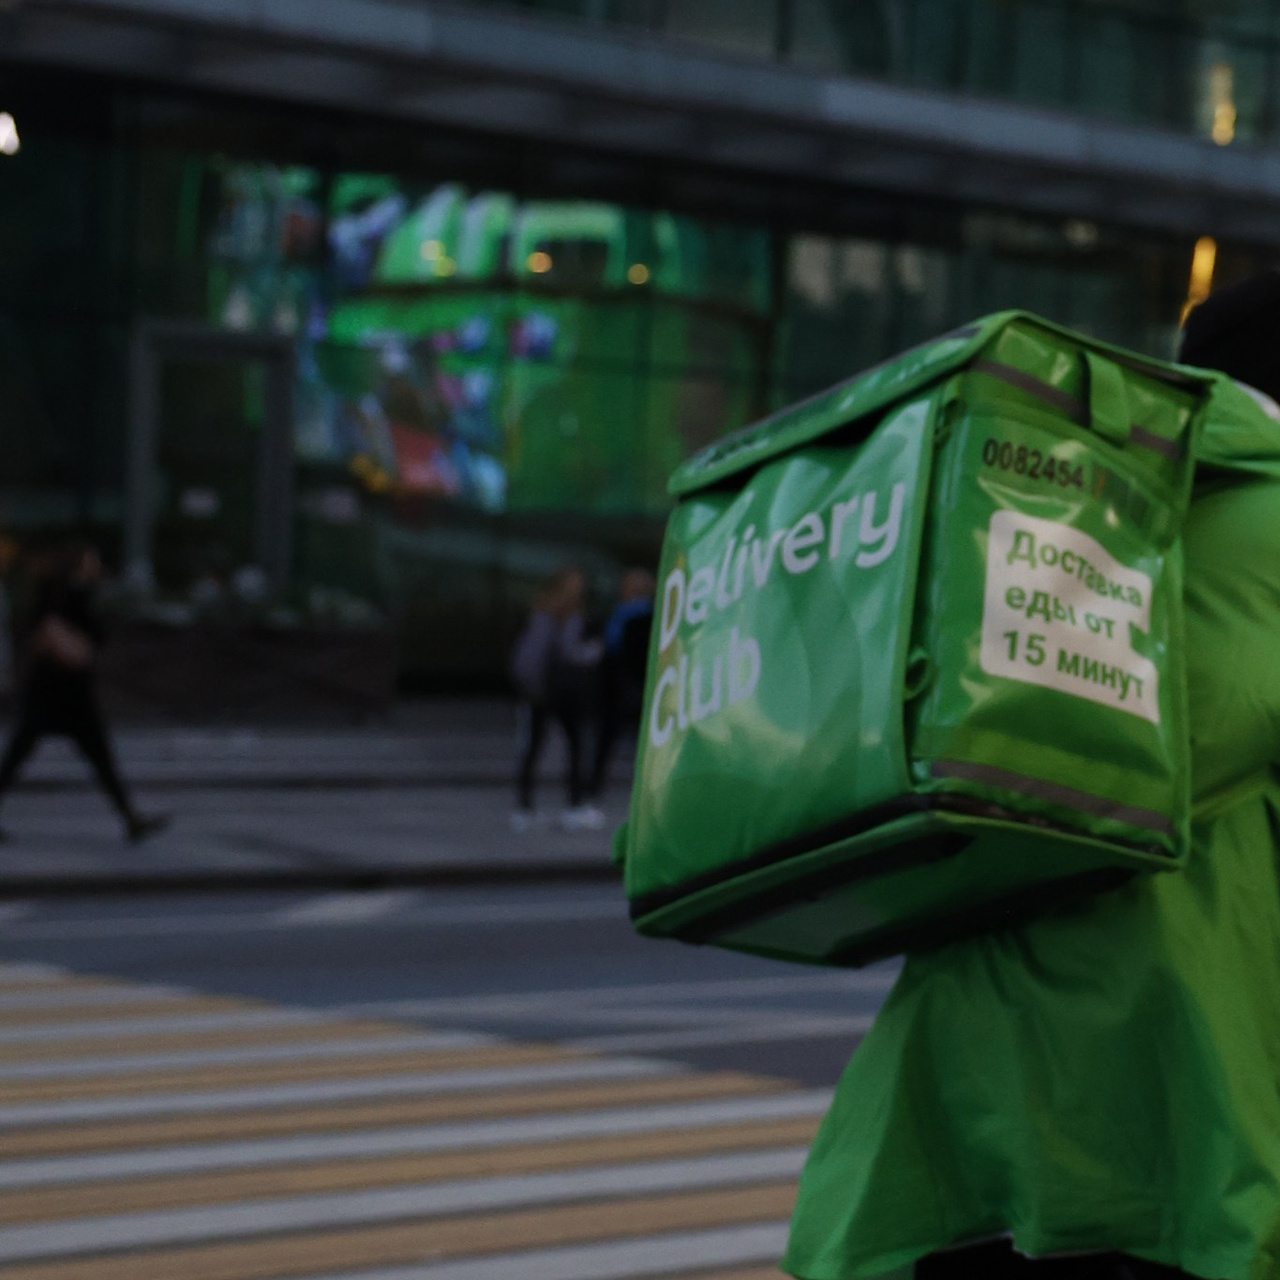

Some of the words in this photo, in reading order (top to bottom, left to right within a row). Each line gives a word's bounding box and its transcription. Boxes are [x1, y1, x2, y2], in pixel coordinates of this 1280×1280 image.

[982, 438, 1084, 489] 0082454
[659, 482, 905, 654] Delivery
[1006, 528, 1144, 608] Доставка
[1004, 585, 1078, 626] еды
[1084, 612, 1116, 640] от
[651, 628, 760, 747] Club
[1002, 629, 1047, 666] 15
[1056, 648, 1145, 701] минут
